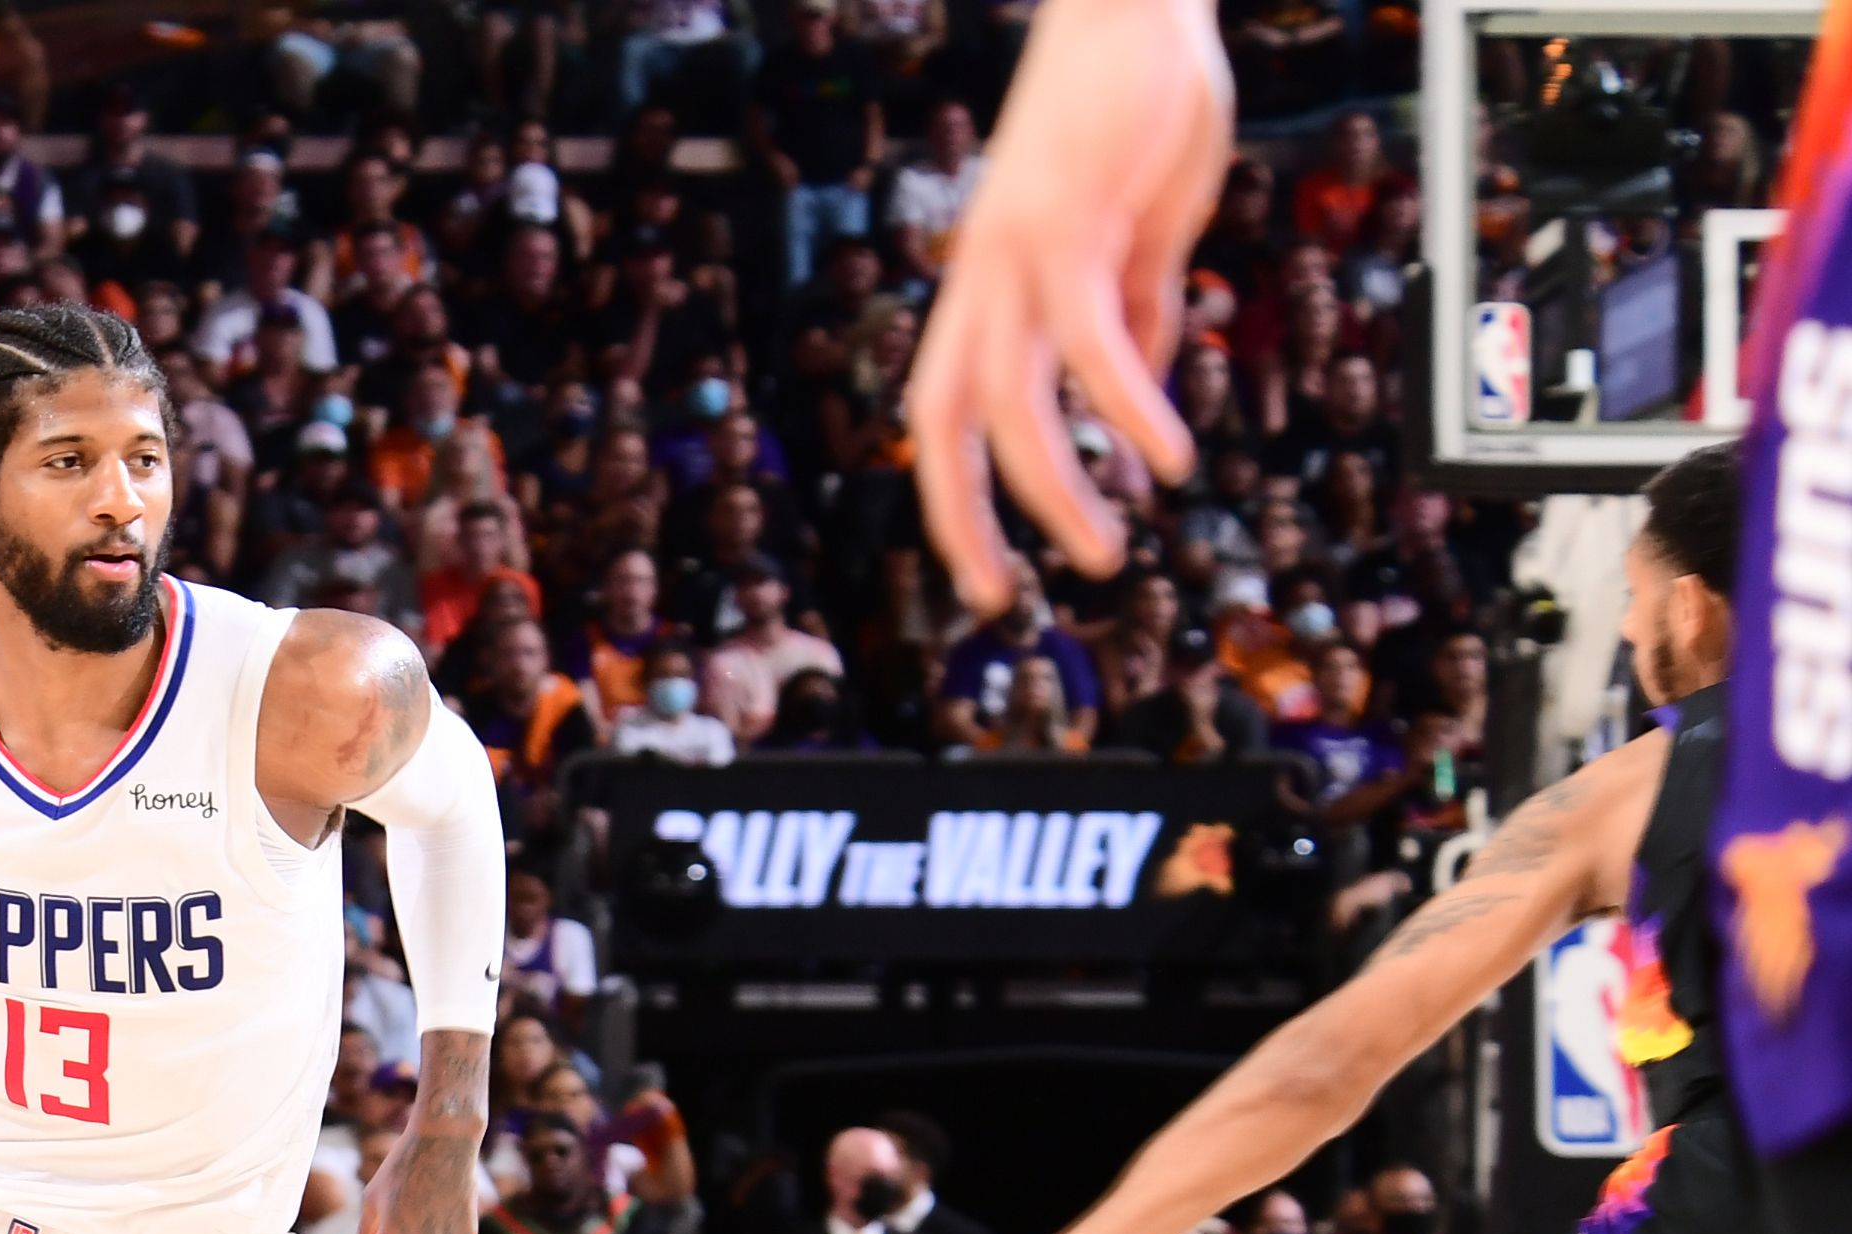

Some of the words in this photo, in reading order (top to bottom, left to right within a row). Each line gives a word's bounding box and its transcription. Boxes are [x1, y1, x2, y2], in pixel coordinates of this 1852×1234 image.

[1771, 317, 1852, 784] SUNS
[129, 783, 219, 819] honey
[839, 841, 926, 908] THE
[924, 811, 1163, 908] VALLEY
[4, 997, 110, 1126] 13
